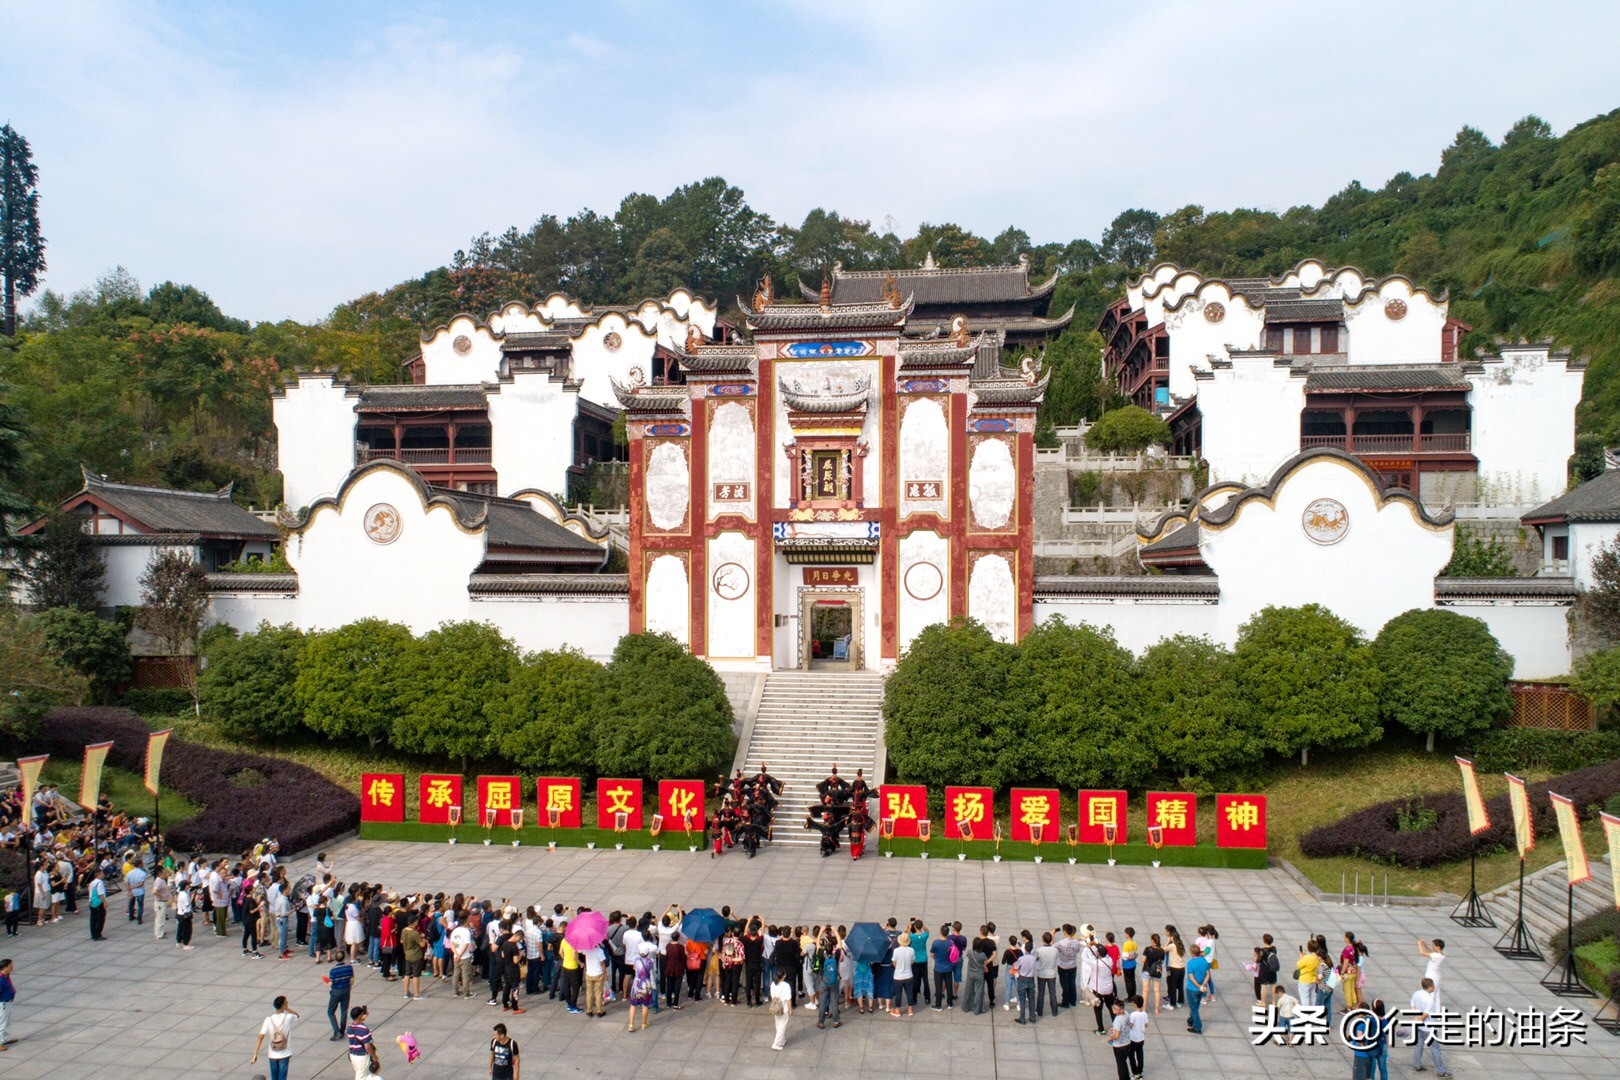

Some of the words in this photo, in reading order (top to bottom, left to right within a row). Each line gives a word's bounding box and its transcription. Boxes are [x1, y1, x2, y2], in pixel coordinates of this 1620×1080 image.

[367, 778, 698, 818] 传承屈原文化
[886, 792, 1259, 831] 弘扬爱国精神
